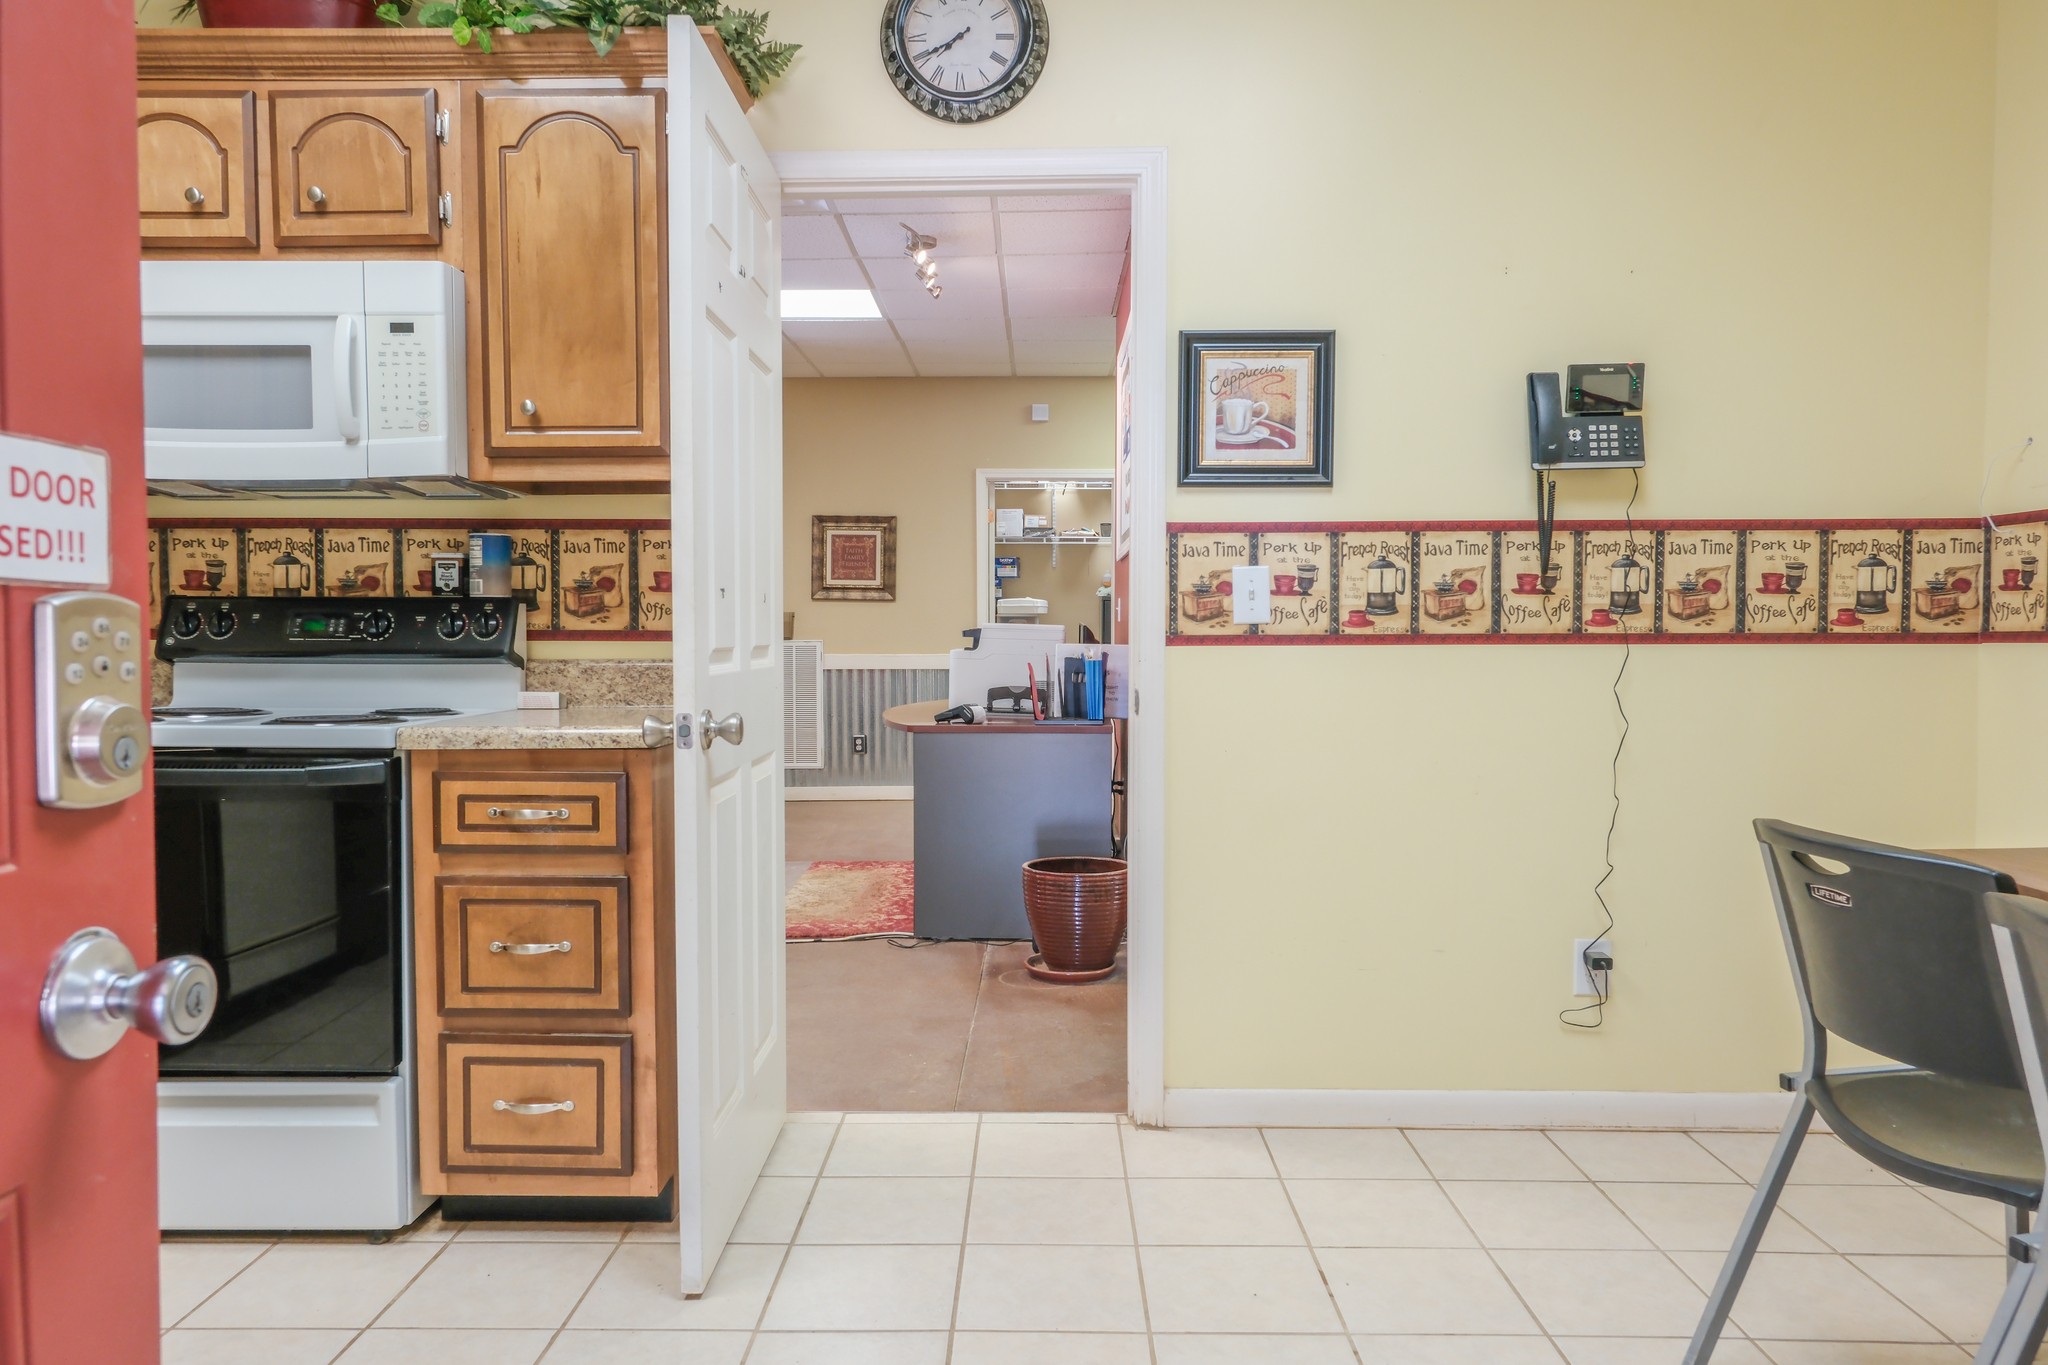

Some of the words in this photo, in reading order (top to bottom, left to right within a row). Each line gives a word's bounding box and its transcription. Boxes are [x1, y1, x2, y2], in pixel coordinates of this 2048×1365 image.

[1209, 364, 1285, 396] Cappuccino
[10, 466, 96, 509] DOOR
[172, 538, 207, 551] Perk
[212, 537, 230, 551] Up
[247, 537, 282, 563] French
[285, 537, 314, 560] Roast
[327, 540, 355, 553] Java
[357, 537, 390, 553] Time
[406, 538, 442, 552] Perk
[446, 538, 465, 552] Up
[521, 538, 549, 561] Roast
[563, 539, 591, 554] Java
[593, 537, 626, 554] Time
[1181, 543, 1210, 558] Java
[1213, 541, 1246, 558] Time
[1263, 542, 1298, 556] Perk
[1304, 541, 1323, 556] Up
[1424, 542, 1452, 556] Java
[1455, 540, 1488, 556] Time
[1506, 540, 1541, 554] Perk
[1668, 541, 1697, 555] Java
[1700, 539, 1734, 555] Time
[1751, 540, 1787, 553] Perk
[1793, 539, 1811, 553] Up
[1916, 540, 1946, 555] Java
[1950, 537, 1983, 554] Time
[1995, 534, 2022, 550] Perk
[2027, 532, 2042, 546] Up
[201, 551, 219, 559] the
[1341, 541, 1377, 567] French
[1380, 540, 1410, 564] Roast
[1584, 540, 1622, 566] French
[1625, 539, 1654, 563] Roast
[1830, 539, 1868, 565] French
[1871, 538, 1902, 563] Roast
[639, 591, 672, 621] Coffe
[1502, 593, 1541, 625] Coffee
[1745, 593, 1787, 624] Coffee
[1991, 590, 2021, 622] Coffee
[1270, 606, 1299, 625] ffee
[1814, 887, 1849, 904] LIFETIME
